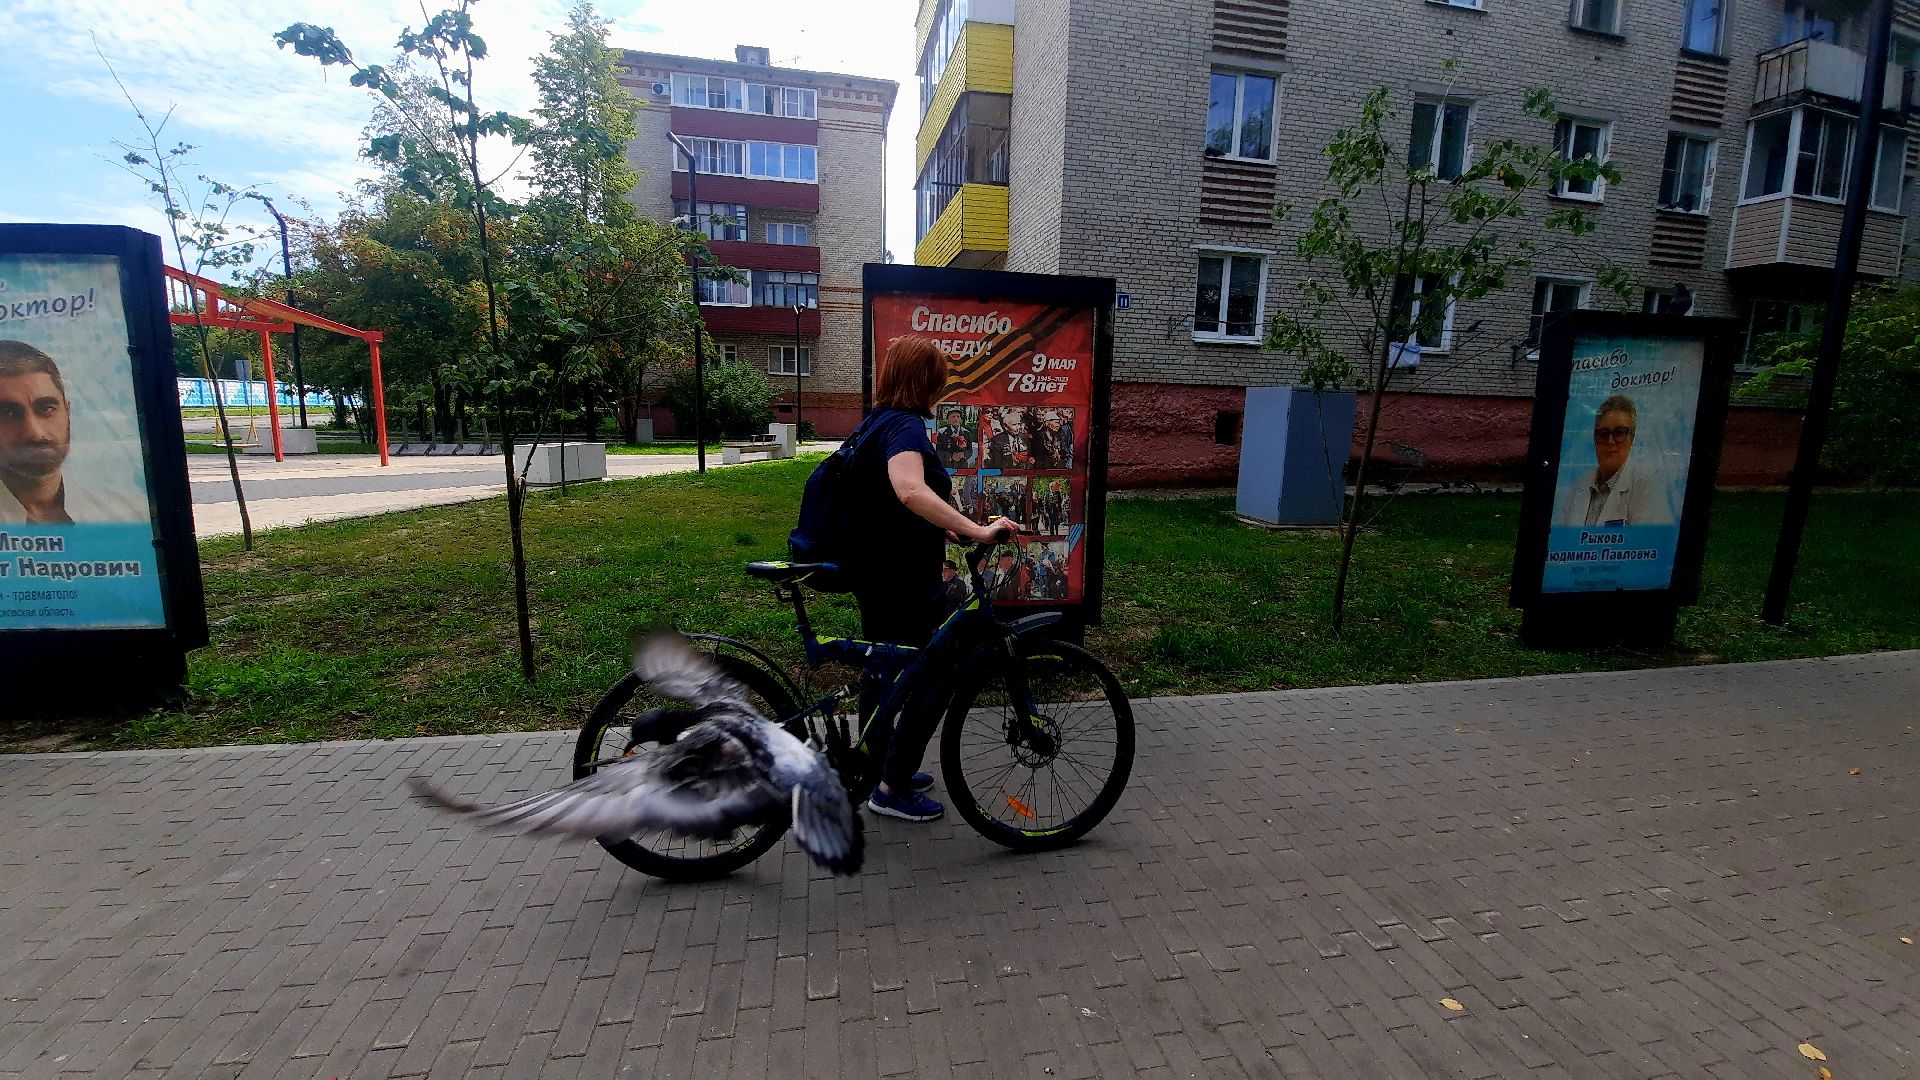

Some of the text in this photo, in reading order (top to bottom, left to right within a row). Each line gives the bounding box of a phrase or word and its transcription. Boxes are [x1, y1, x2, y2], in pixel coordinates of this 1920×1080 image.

[911, 306, 1012, 334] Спасибо
[1031, 353, 1077, 373] 9 МАЯ
[1007, 373, 1036, 393] 78
[1611, 366, 1675, 388] доктор!
[1580, 531, 1624, 544] Рыкова
[1601, 548, 1657, 560] Павловна
[17, 557, 140, 581] Надрович
